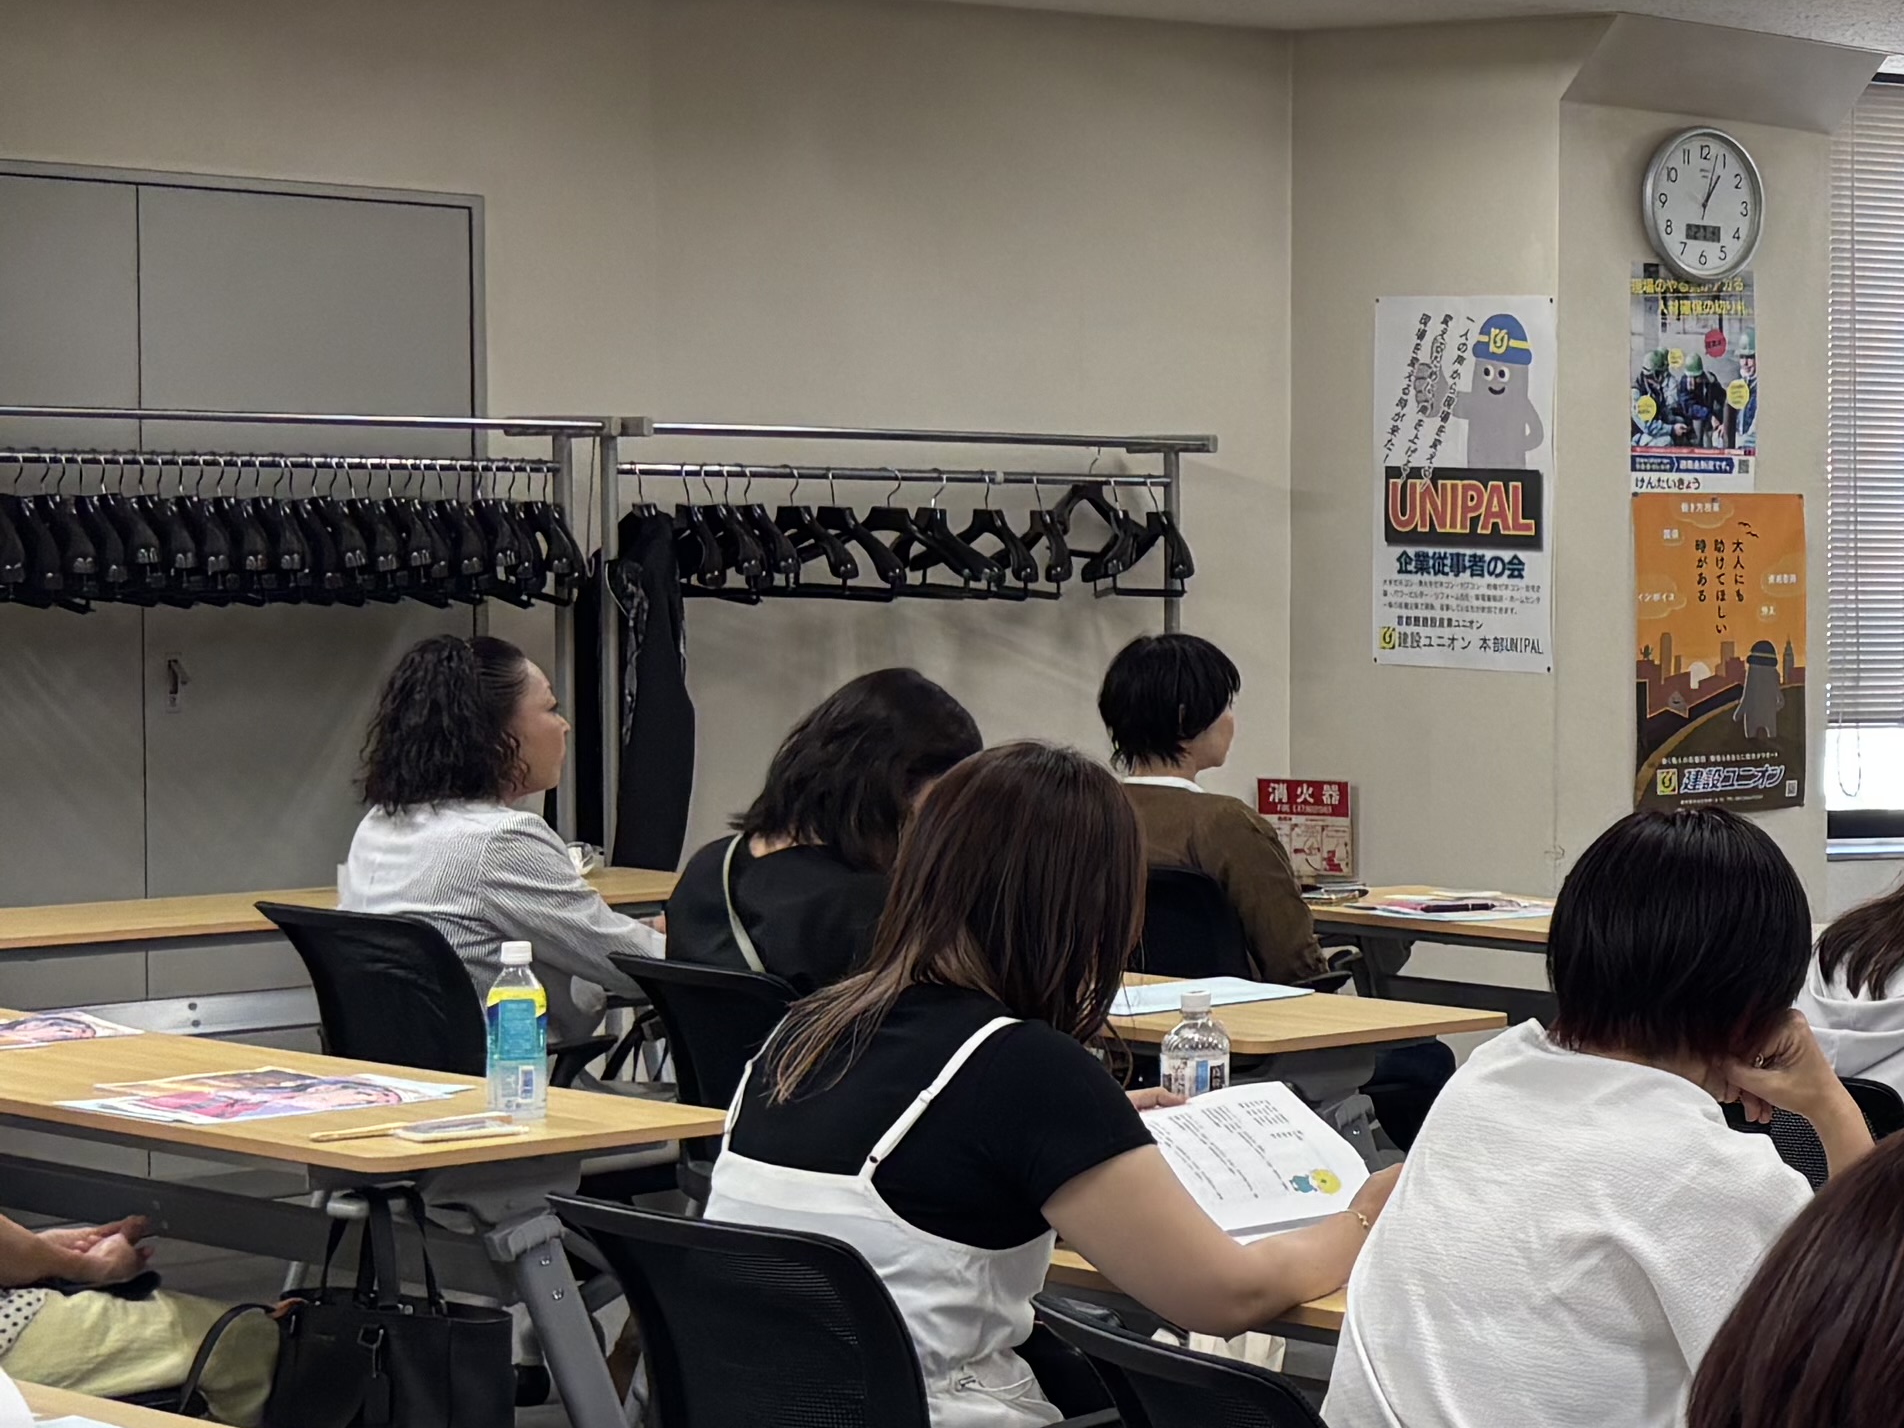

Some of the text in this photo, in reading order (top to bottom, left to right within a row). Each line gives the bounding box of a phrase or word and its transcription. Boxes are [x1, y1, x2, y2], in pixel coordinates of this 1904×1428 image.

[1683, 149, 1690, 165] 11
[1700, 145, 1711, 160] 12
[1667, 166, 1678, 183] 10
[1734, 173, 1742, 189] 2
[1658, 193, 1668, 208] 9
[1740, 201, 1748, 217] 3
[1665, 219, 1673, 235] 8
[1732, 227, 1741, 241] 4
[1680, 242, 1687, 256] 7
[1718, 245, 1727, 260] 5
[1699, 250, 1707, 265] 6
[1635, 476, 1701, 491] けんたいきょう
[1389, 478, 1536, 536] UNIPAL
[1396, 550, 1526, 580] 企業従事者の会
[1695, 539, 1708, 603] 時がある
[1732, 539, 1745, 603] 大人にも
[1714, 539, 1727, 634] 助けてほしい
[1398, 631, 1472, 651] 建設ユニオン
[1680, 763, 1785, 794] 建設ユニオン
[1268, 782, 1340, 805] 消火器
